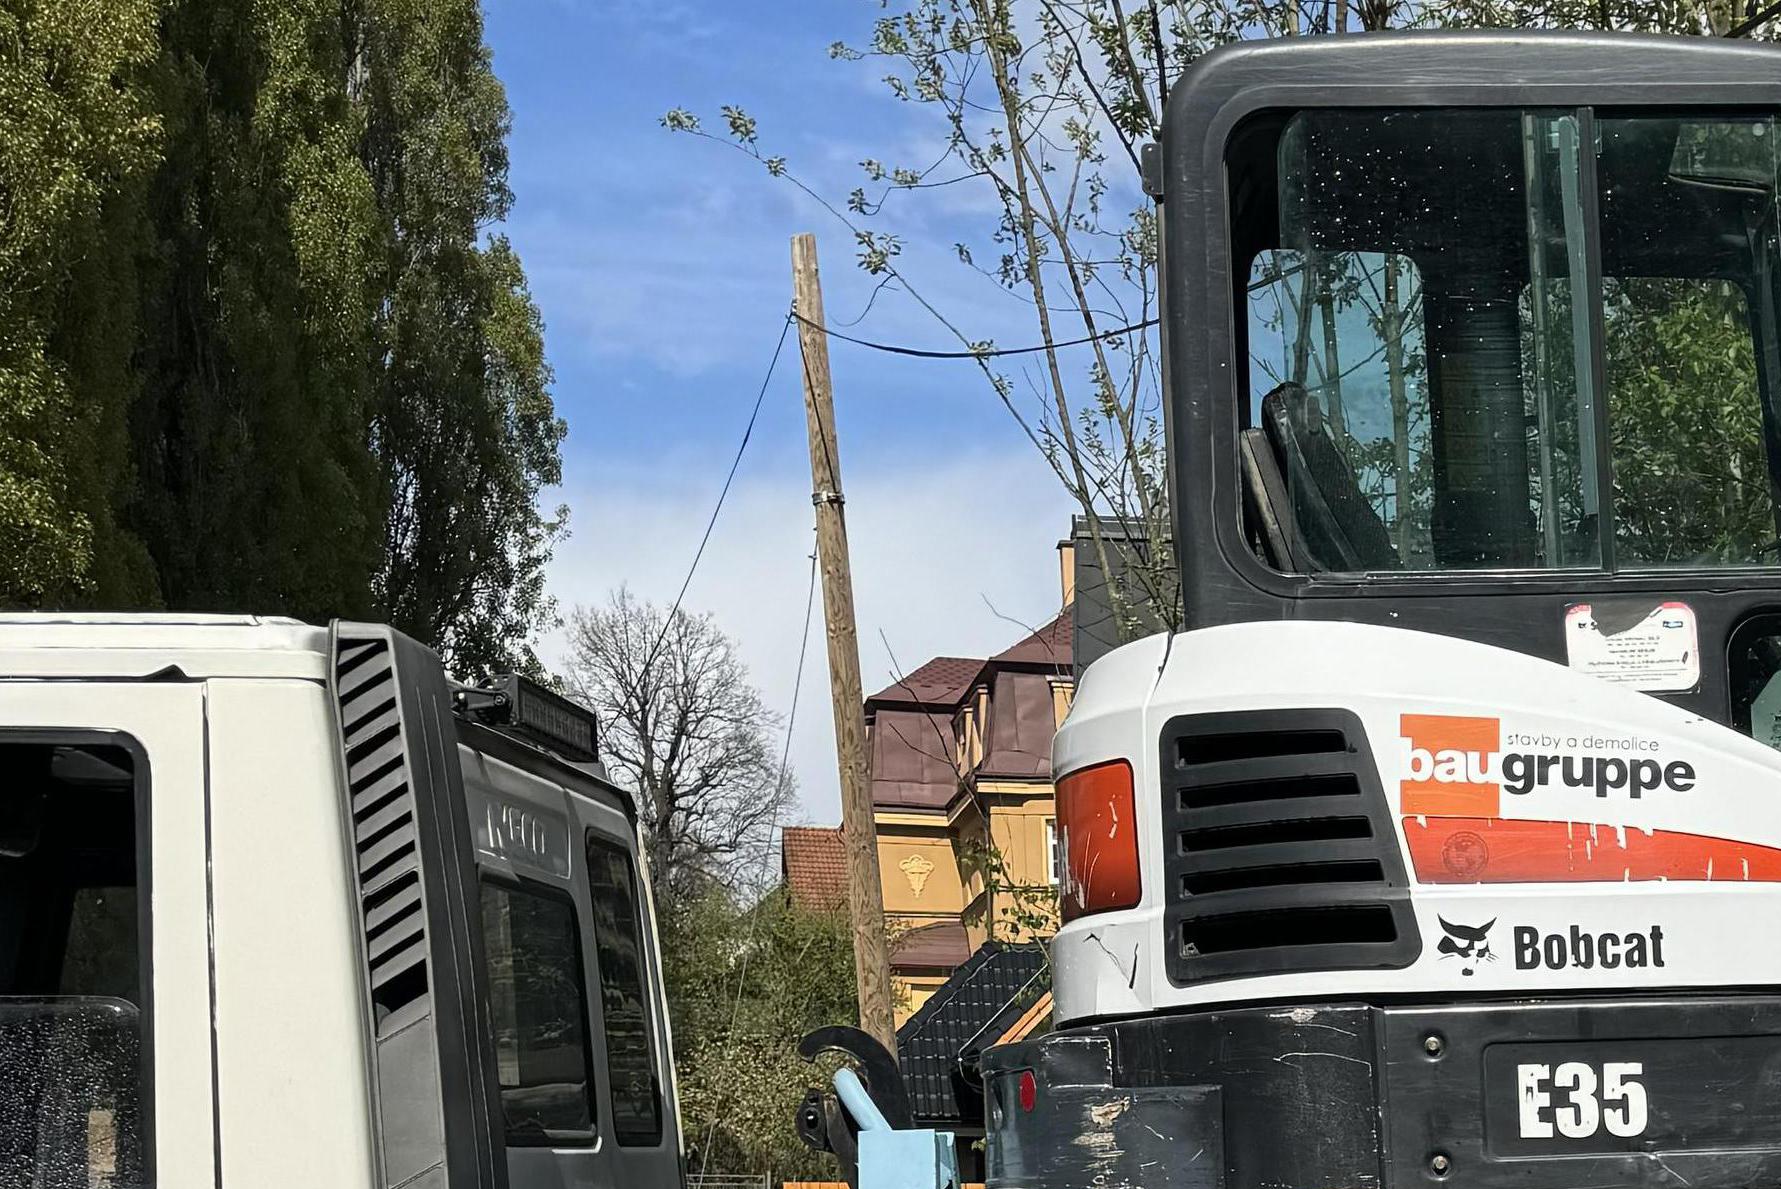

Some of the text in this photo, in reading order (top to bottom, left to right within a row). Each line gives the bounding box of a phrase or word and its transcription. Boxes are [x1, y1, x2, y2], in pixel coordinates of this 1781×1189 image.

[1508, 733, 1659, 751] stavby a demolice
[1514, 925, 1665, 970] Bobcat
[1517, 1062, 1648, 1138] E35
